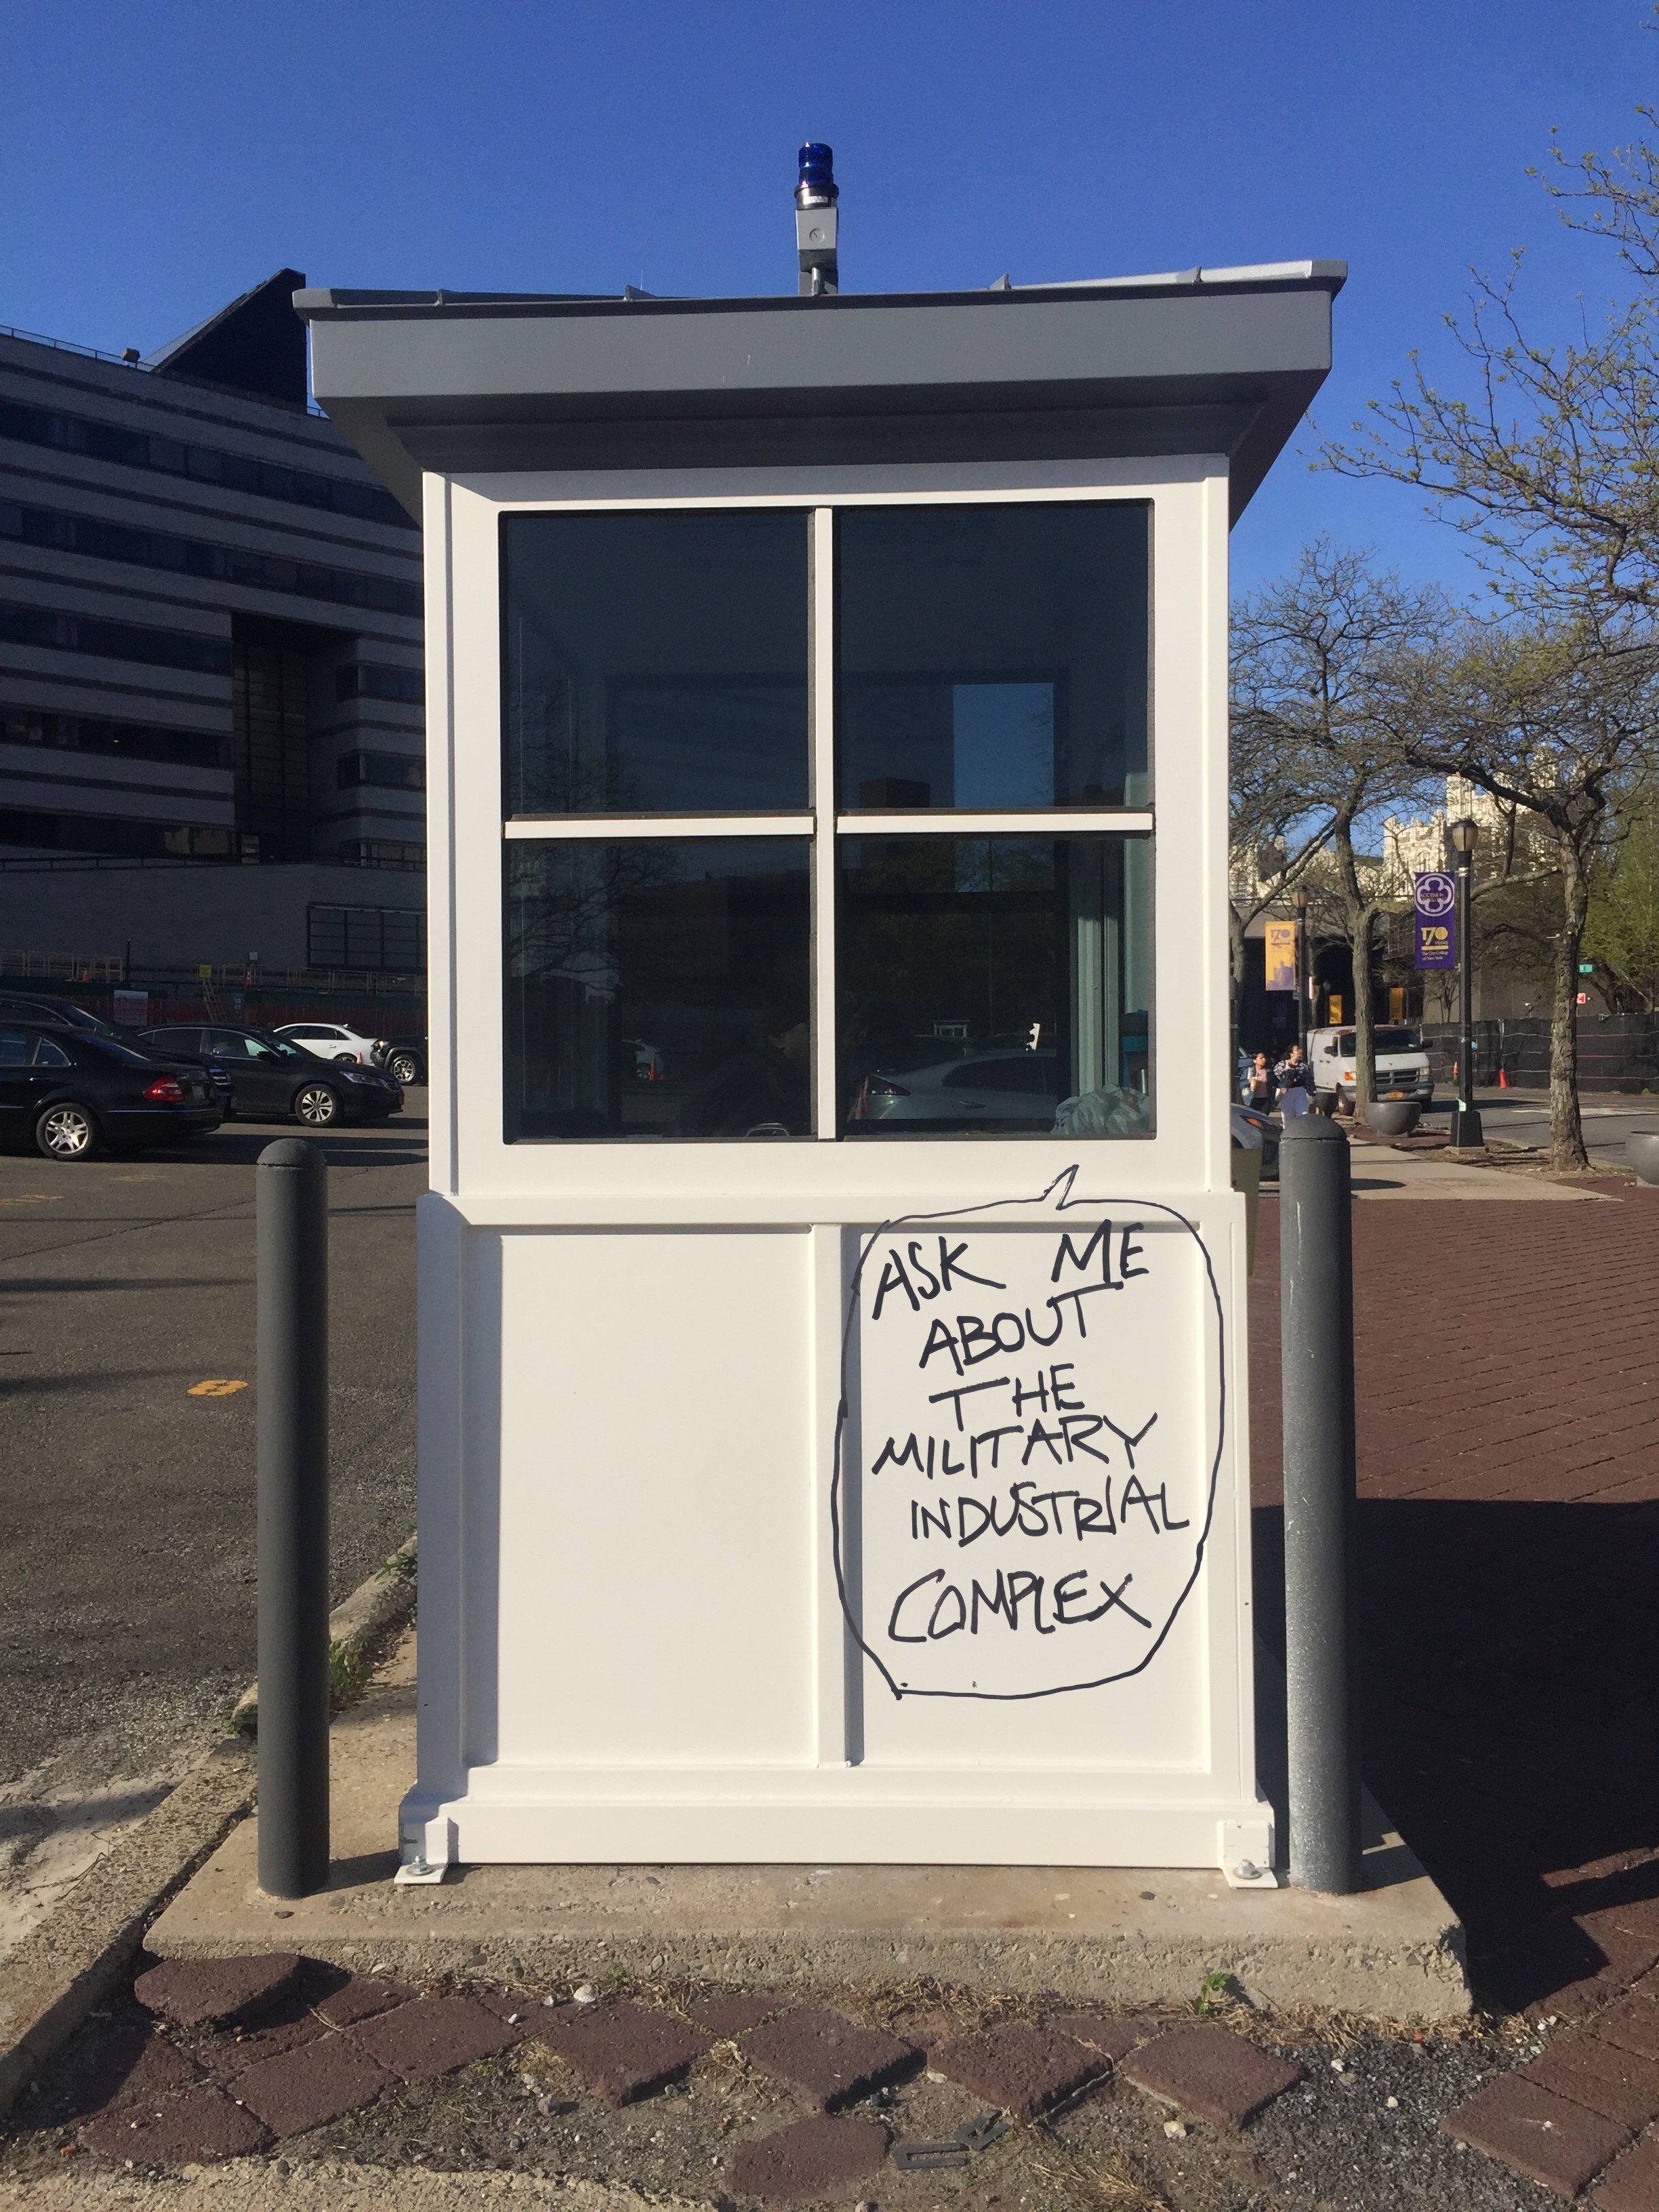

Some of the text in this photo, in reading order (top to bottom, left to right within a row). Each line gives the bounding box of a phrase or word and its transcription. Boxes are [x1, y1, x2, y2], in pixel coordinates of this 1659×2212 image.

[1420, 926, 1448, 945] 170
[872, 1218, 1150, 1320] ASK ME
[919, 1280, 1124, 1376] ABOUT
[929, 1363, 1085, 1431] THE
[872, 1413, 1158, 1479] MILITARY
[912, 1475, 1190, 1547] INDUSTRIAL
[888, 1569, 1151, 1642] COMPLEX
